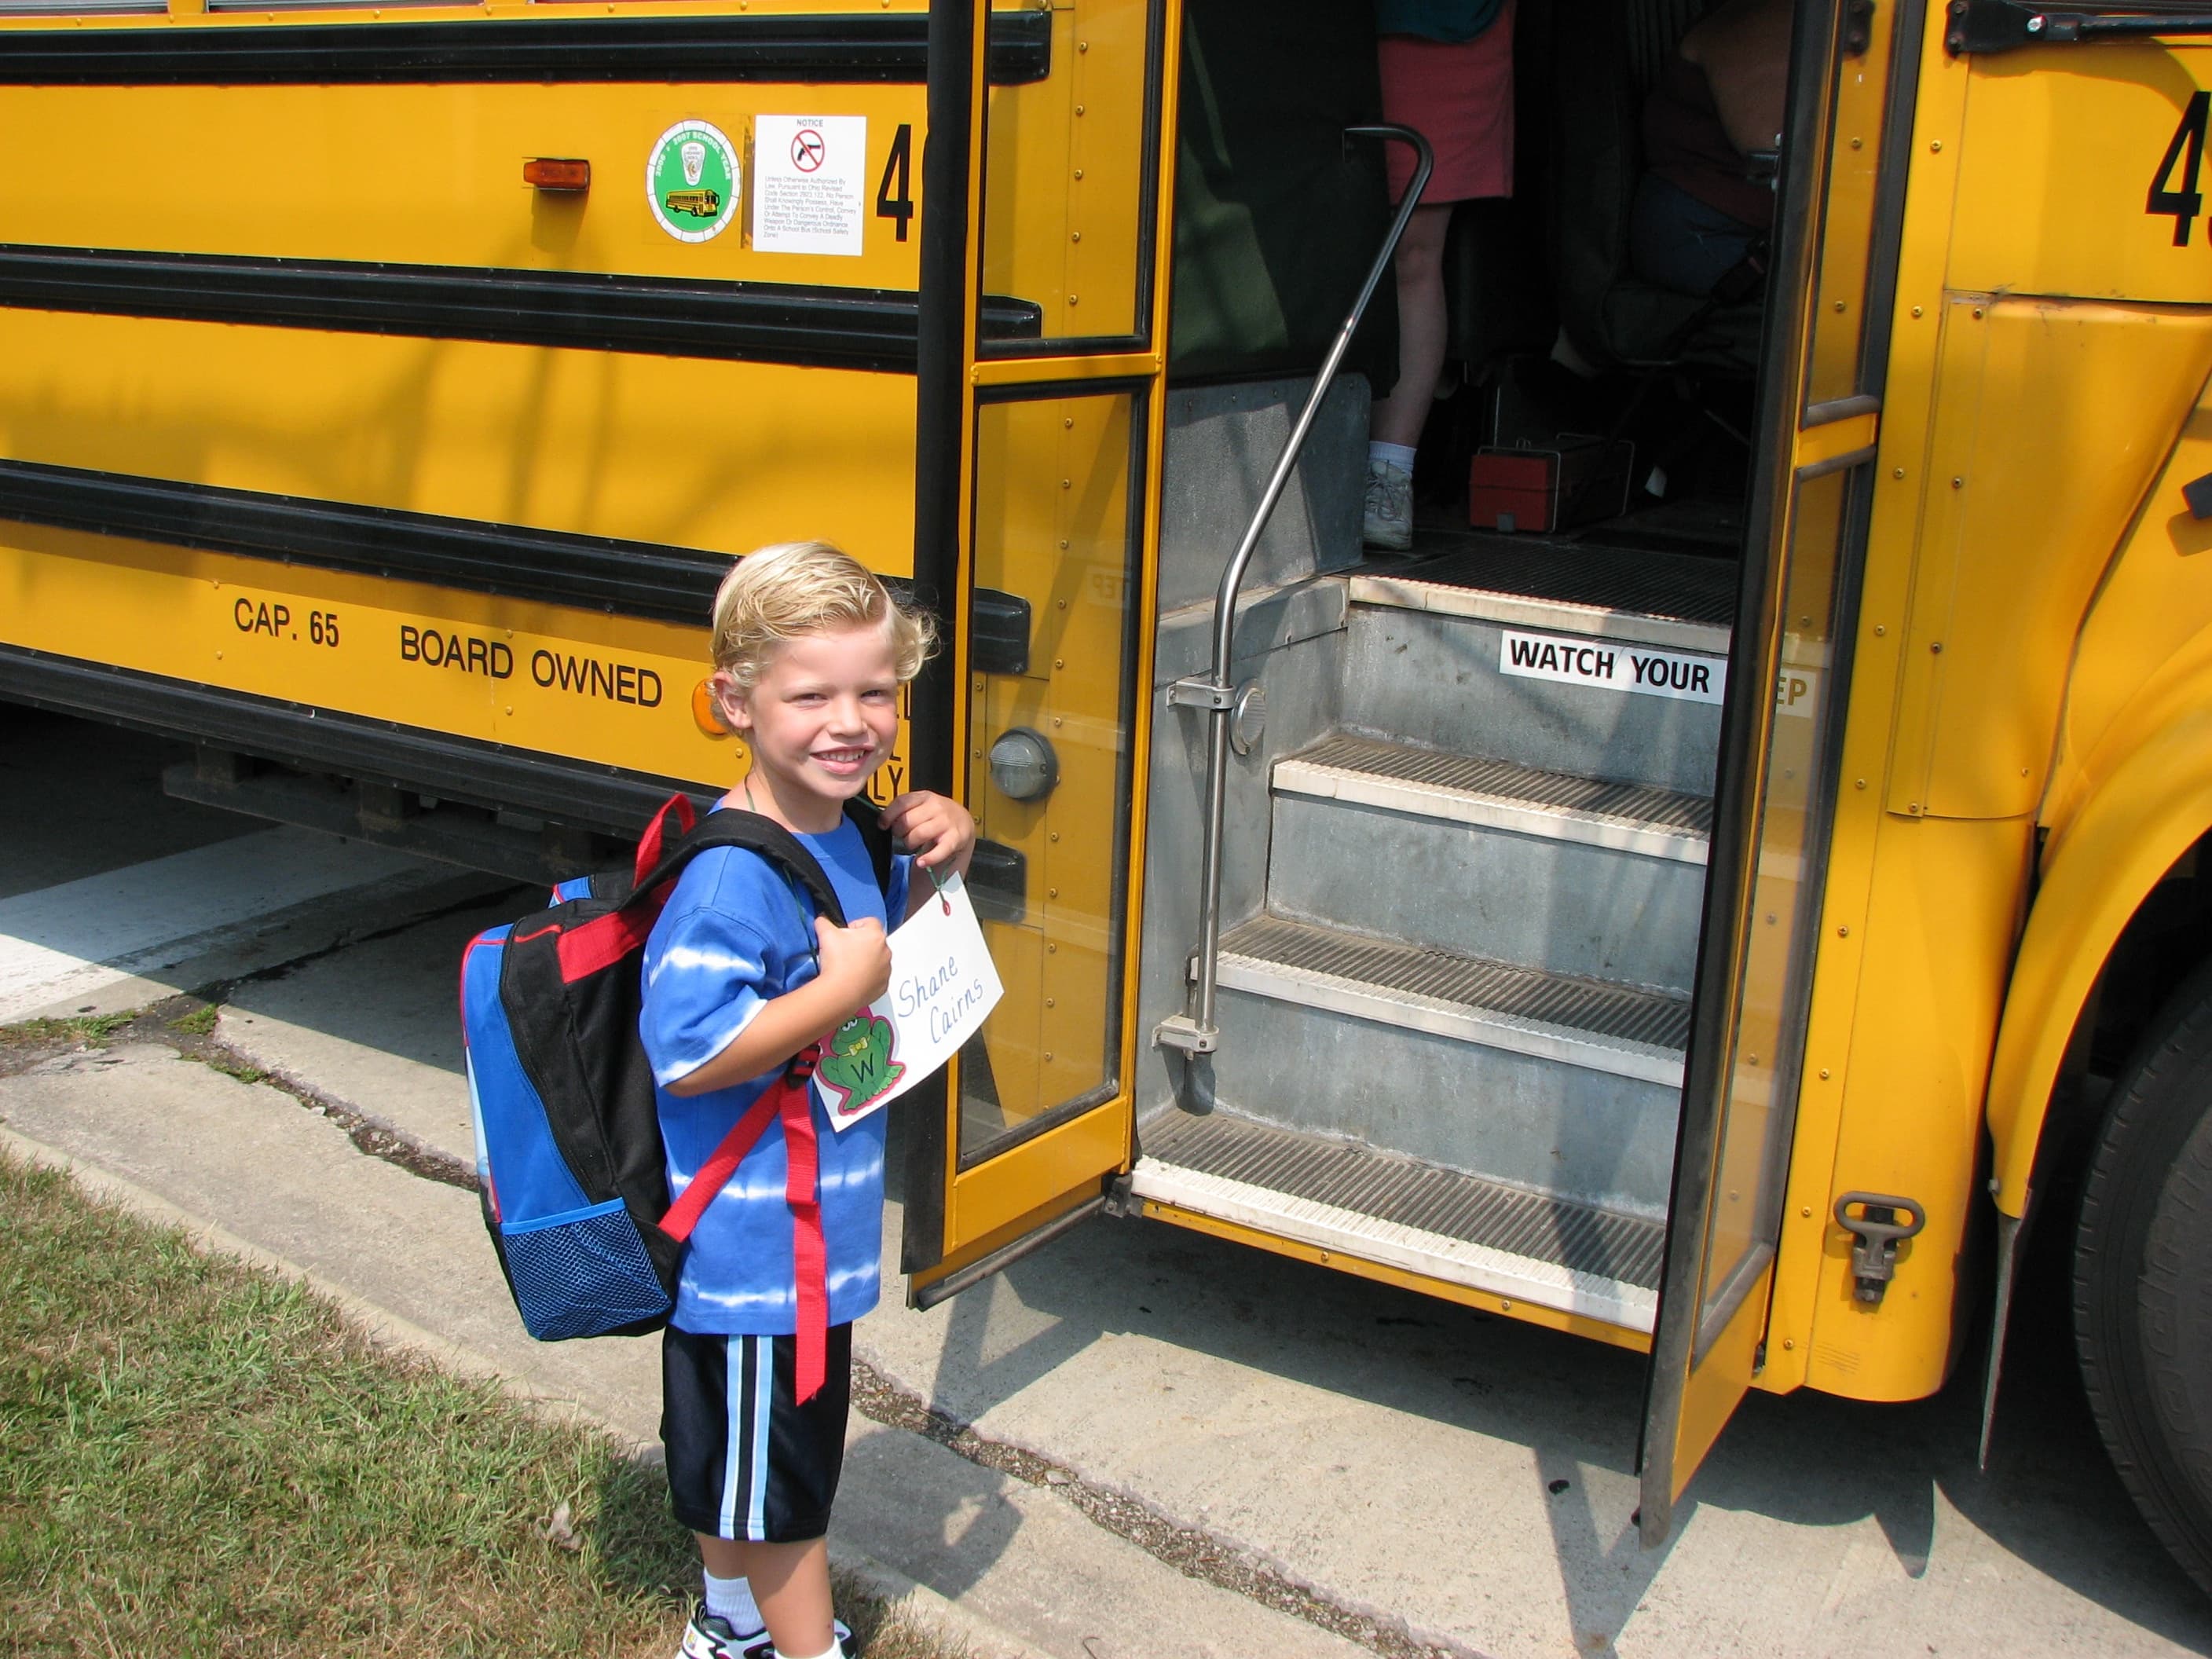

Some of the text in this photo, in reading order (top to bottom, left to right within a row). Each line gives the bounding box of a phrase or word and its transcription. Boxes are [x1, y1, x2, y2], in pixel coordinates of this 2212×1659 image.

[797, 119, 824, 127] NOTICE
[691, 131, 721, 155] SCHOOL
[720, 153, 731, 181] YEAR
[877, 124, 913, 242] 4
[2144, 90, 2212, 247] 4
[235, 598, 339, 647] CAP. 65
[401, 625, 663, 708] BOARD OWNED
[1510, 639, 1807, 705] WATCH YOUR EP
[898, 955, 958, 1018] Shane
[929, 979, 984, 1044] Cairns
[850, 1052, 876, 1084] W
